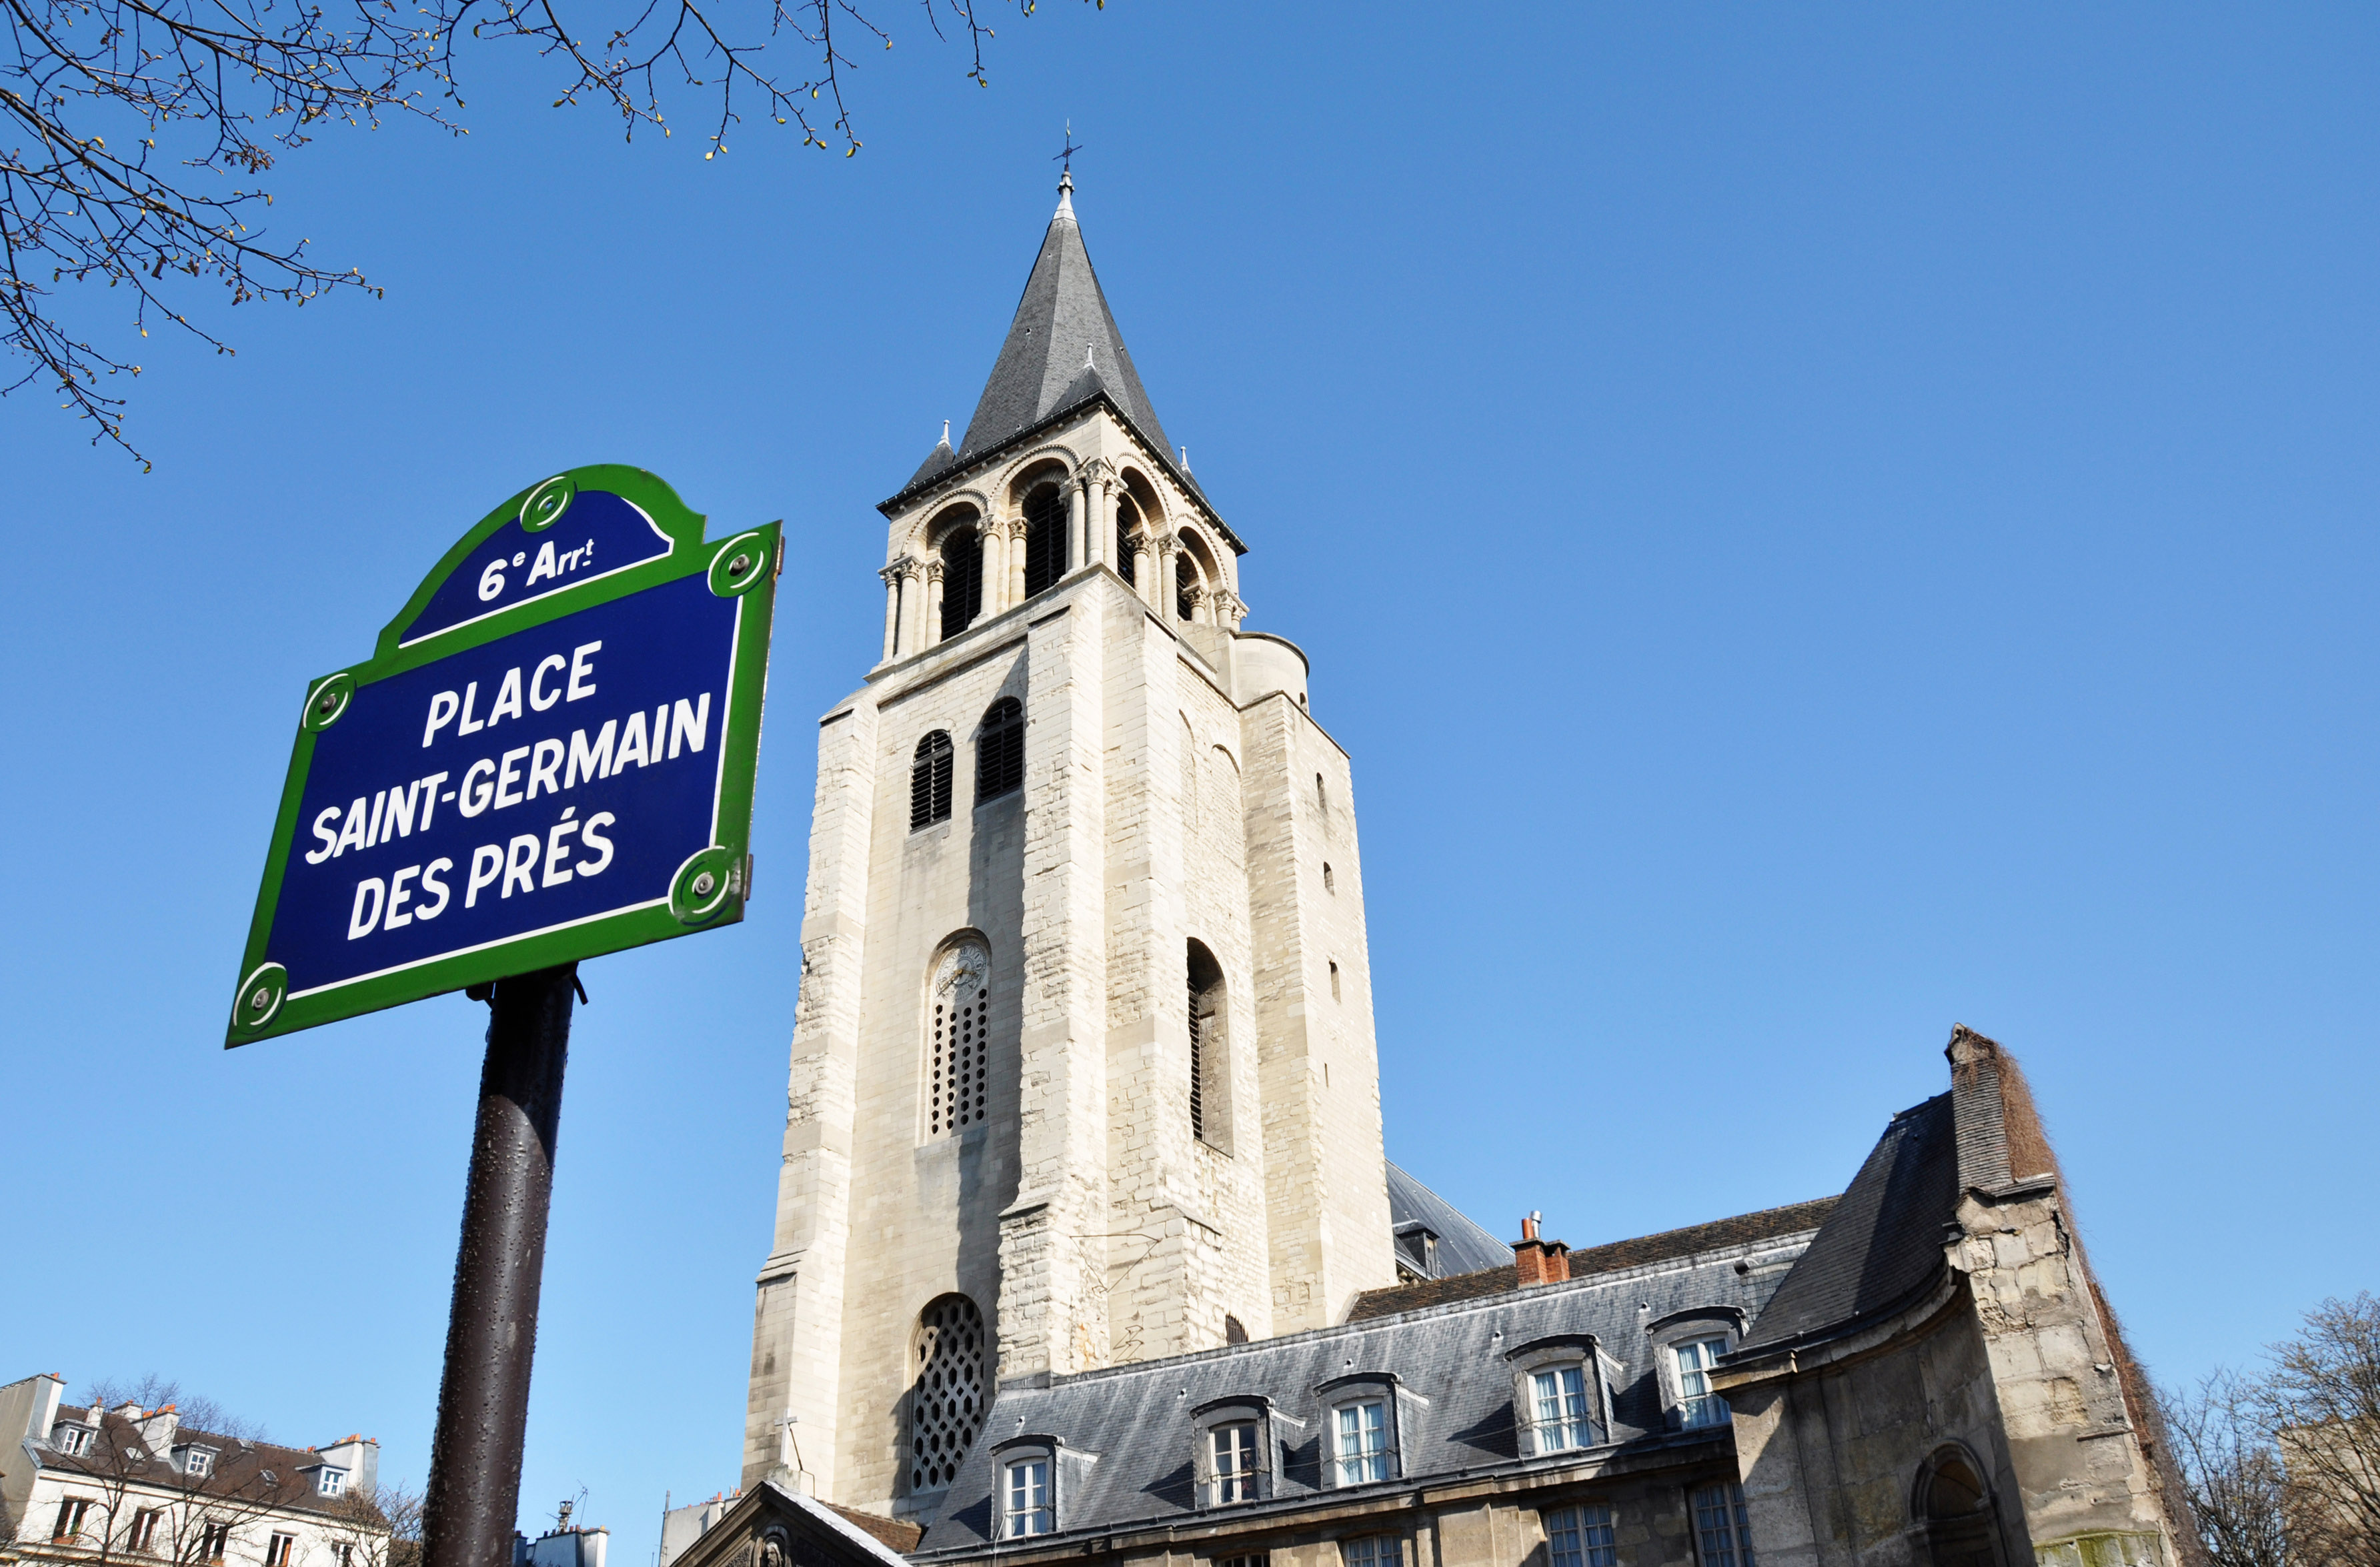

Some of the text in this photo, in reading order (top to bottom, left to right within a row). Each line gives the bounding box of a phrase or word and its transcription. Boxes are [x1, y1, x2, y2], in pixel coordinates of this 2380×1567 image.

[421, 640, 603, 748] PLACE
[304, 692, 712, 866] SAINT-GERMAIN
[347, 806, 616, 942] DES PRÉS
